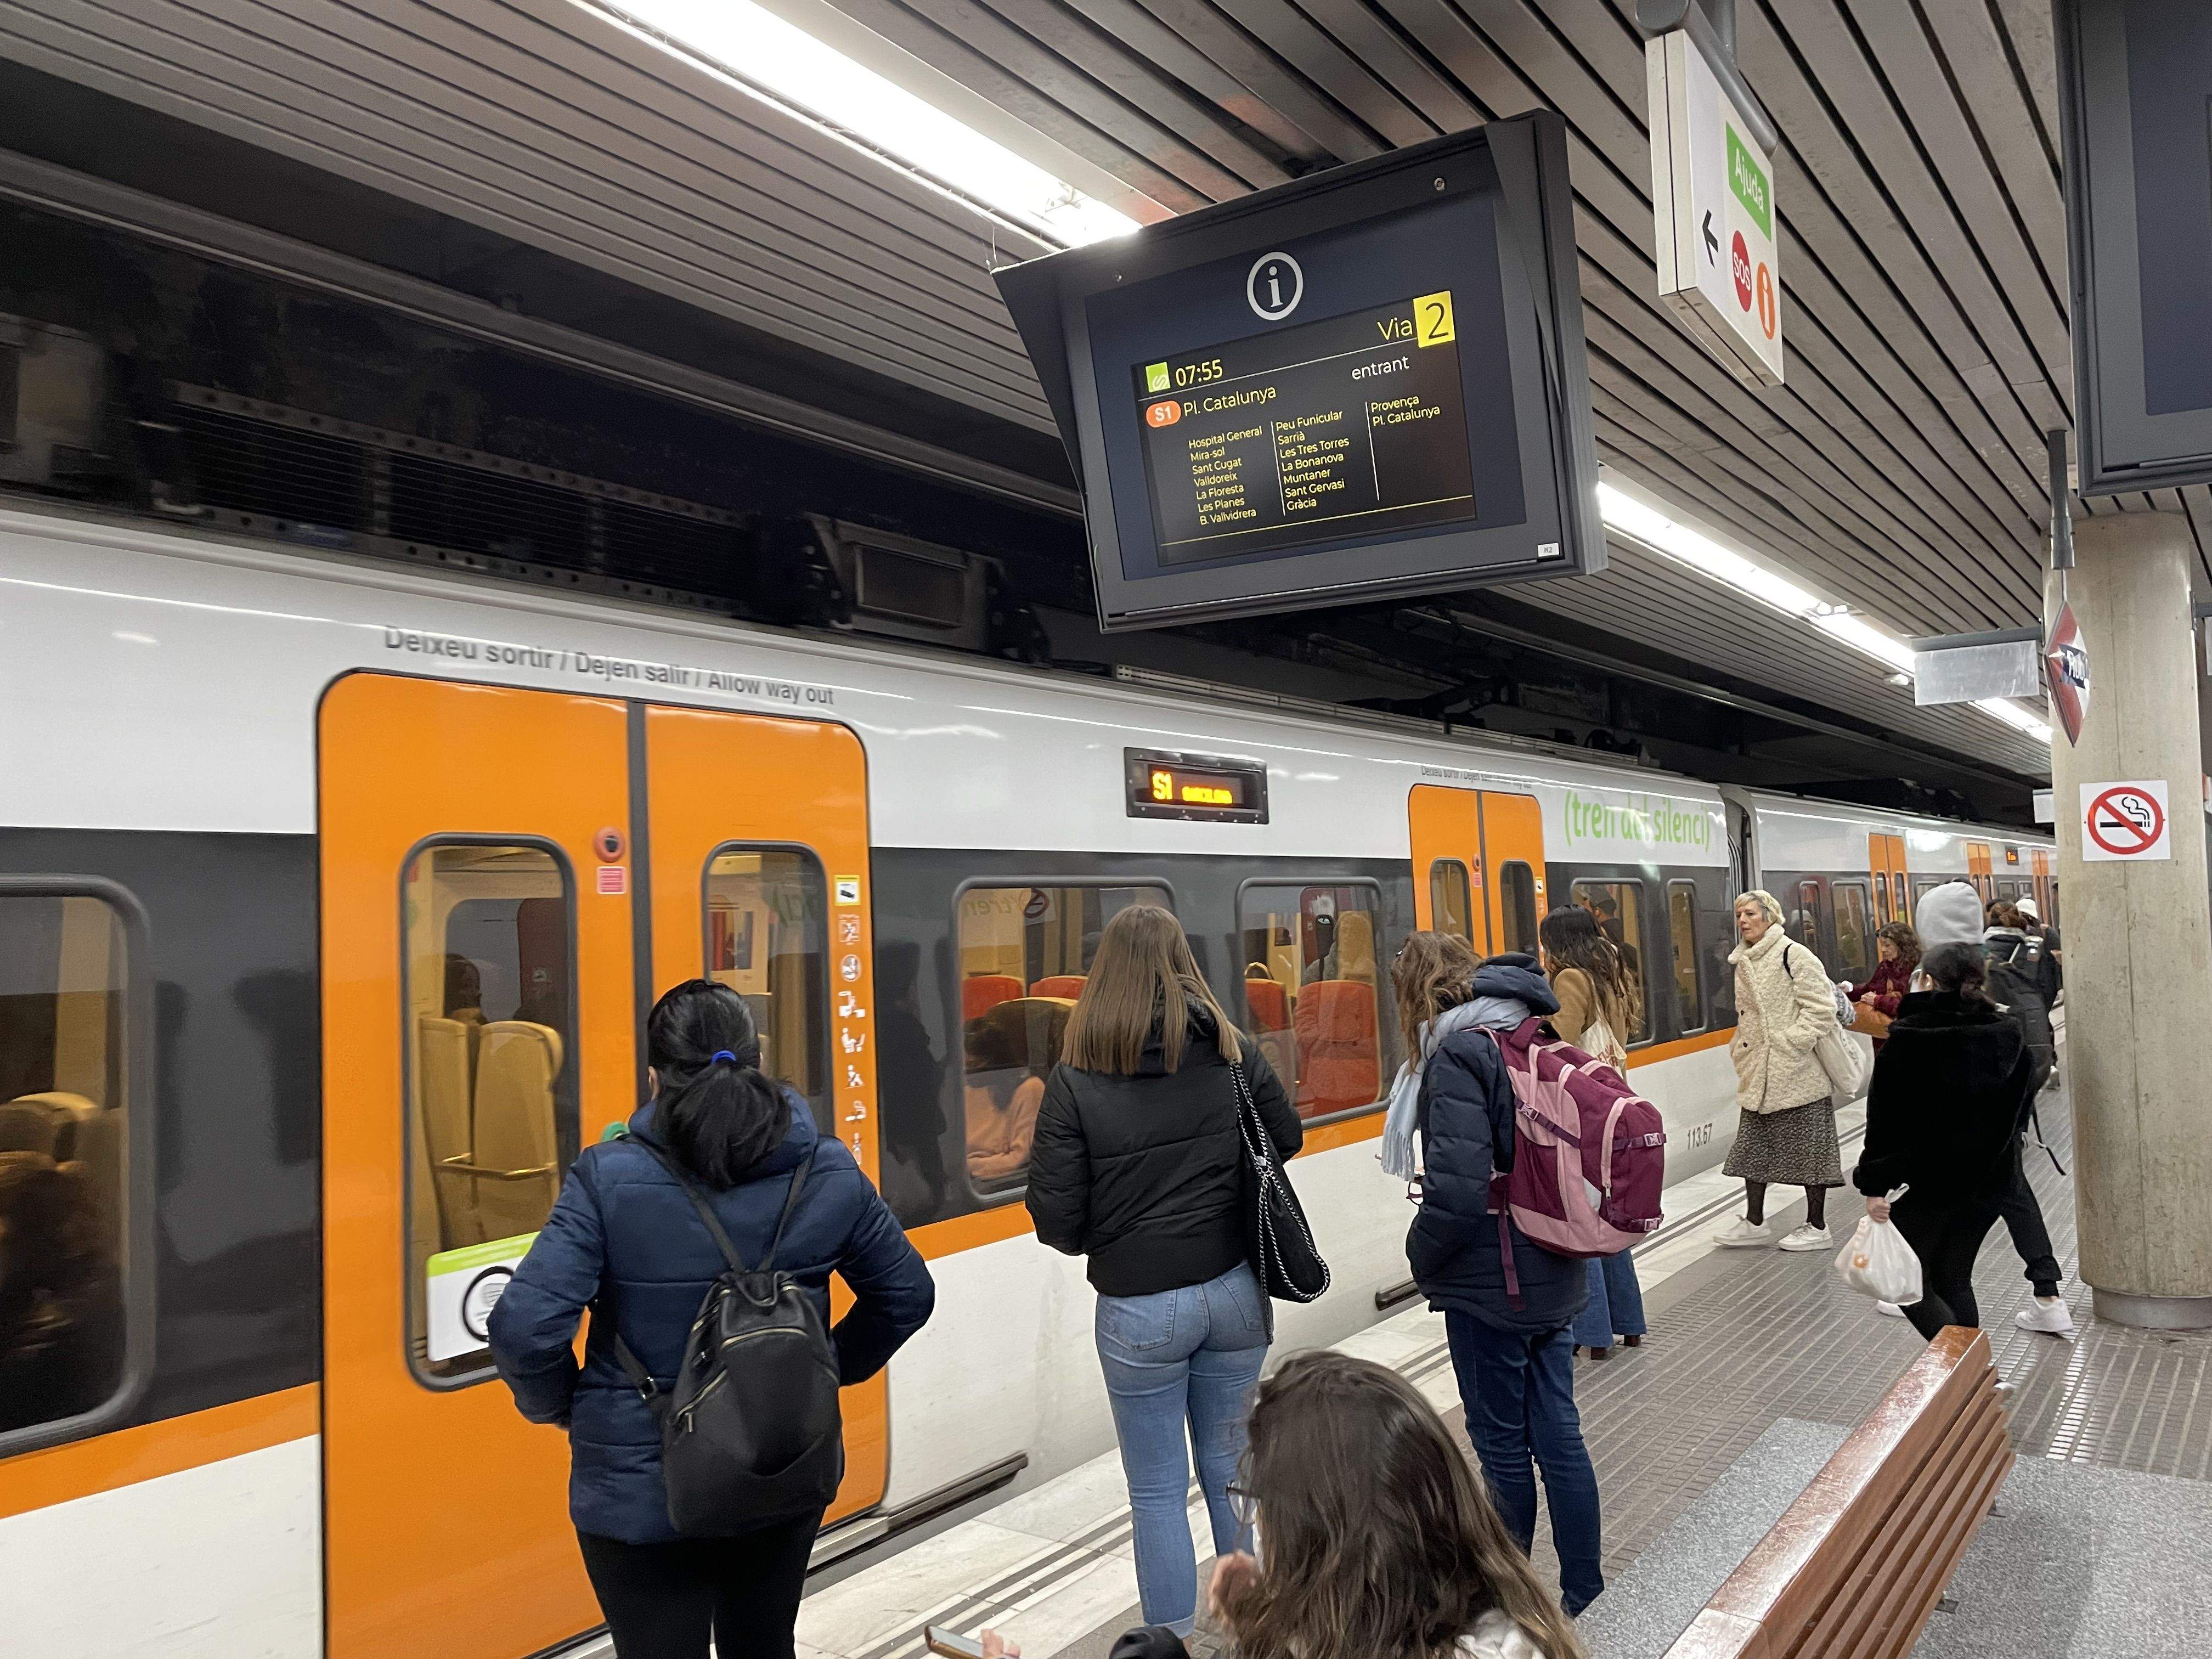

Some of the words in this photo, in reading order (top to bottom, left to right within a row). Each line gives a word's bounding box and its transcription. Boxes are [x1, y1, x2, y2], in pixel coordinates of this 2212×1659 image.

[1735, 146, 1765, 214] Ajuda
[1733, 251, 1751, 291] SOS
[1377, 317, 1413, 341] Via
[1425, 302, 1449, 340] 2
[1175, 359, 1223, 387] 07:55
[1351, 356, 1410, 380] entrant
[1154, 405, 1172, 422] S1
[1183, 400, 1201, 417] Pl.
[1203, 386, 1277, 412] Catalunya
[1370, 395, 1420, 413] Provença
[1276, 421, 1295, 432] Peu
[1296, 410, 1343, 427] Funicular
[1372, 415, 1386, 427] Pl.
[1387, 406, 1441, 424] Catalunya
[1188, 432, 1226, 449] Hospital
[1226, 425, 1263, 441] General
[1277, 431, 1305, 445] Sarrià
[1190, 446, 1226, 462] Mira-sol
[1279, 448, 1296, 459] Les
[1296, 444, 1318, 455] Tres
[1318, 437, 1350, 451] Torres
[1192, 463, 1212, 475] Sant
[1214, 458, 1243, 472] Cugat
[1282, 461, 1293, 472] La
[1295, 452, 1344, 469] Bonanova
[1193, 472, 1238, 487] Valldoreix
[1283, 469, 1331, 484] Muntaner
[1195, 490, 1207, 500] La
[1208, 484, 1245, 499] Floresta
[1284, 484, 1307, 498] Sant
[1308, 478, 1345, 494] Gervasi
[1198, 502, 1214, 512] Les
[1214, 496, 1245, 510] Planes
[1286, 497, 1317, 511] Gràcia
[1199, 515, 1210, 526] B.
[1210, 508, 1257, 523] Vallvidrera
[385, 625, 477, 659] Deixeu
[486, 646, 552, 669] sortir
[575, 651, 637, 682] Dejen
[645, 664, 689, 685] salir
[707, 673, 762, 696] Allow
[766, 682, 801, 704] way
[806, 687, 834, 706] out
[1152, 771, 1173, 800] S1
[1565, 789, 1616, 847] (tren
[1654, 795, 1711, 853] silenci)
